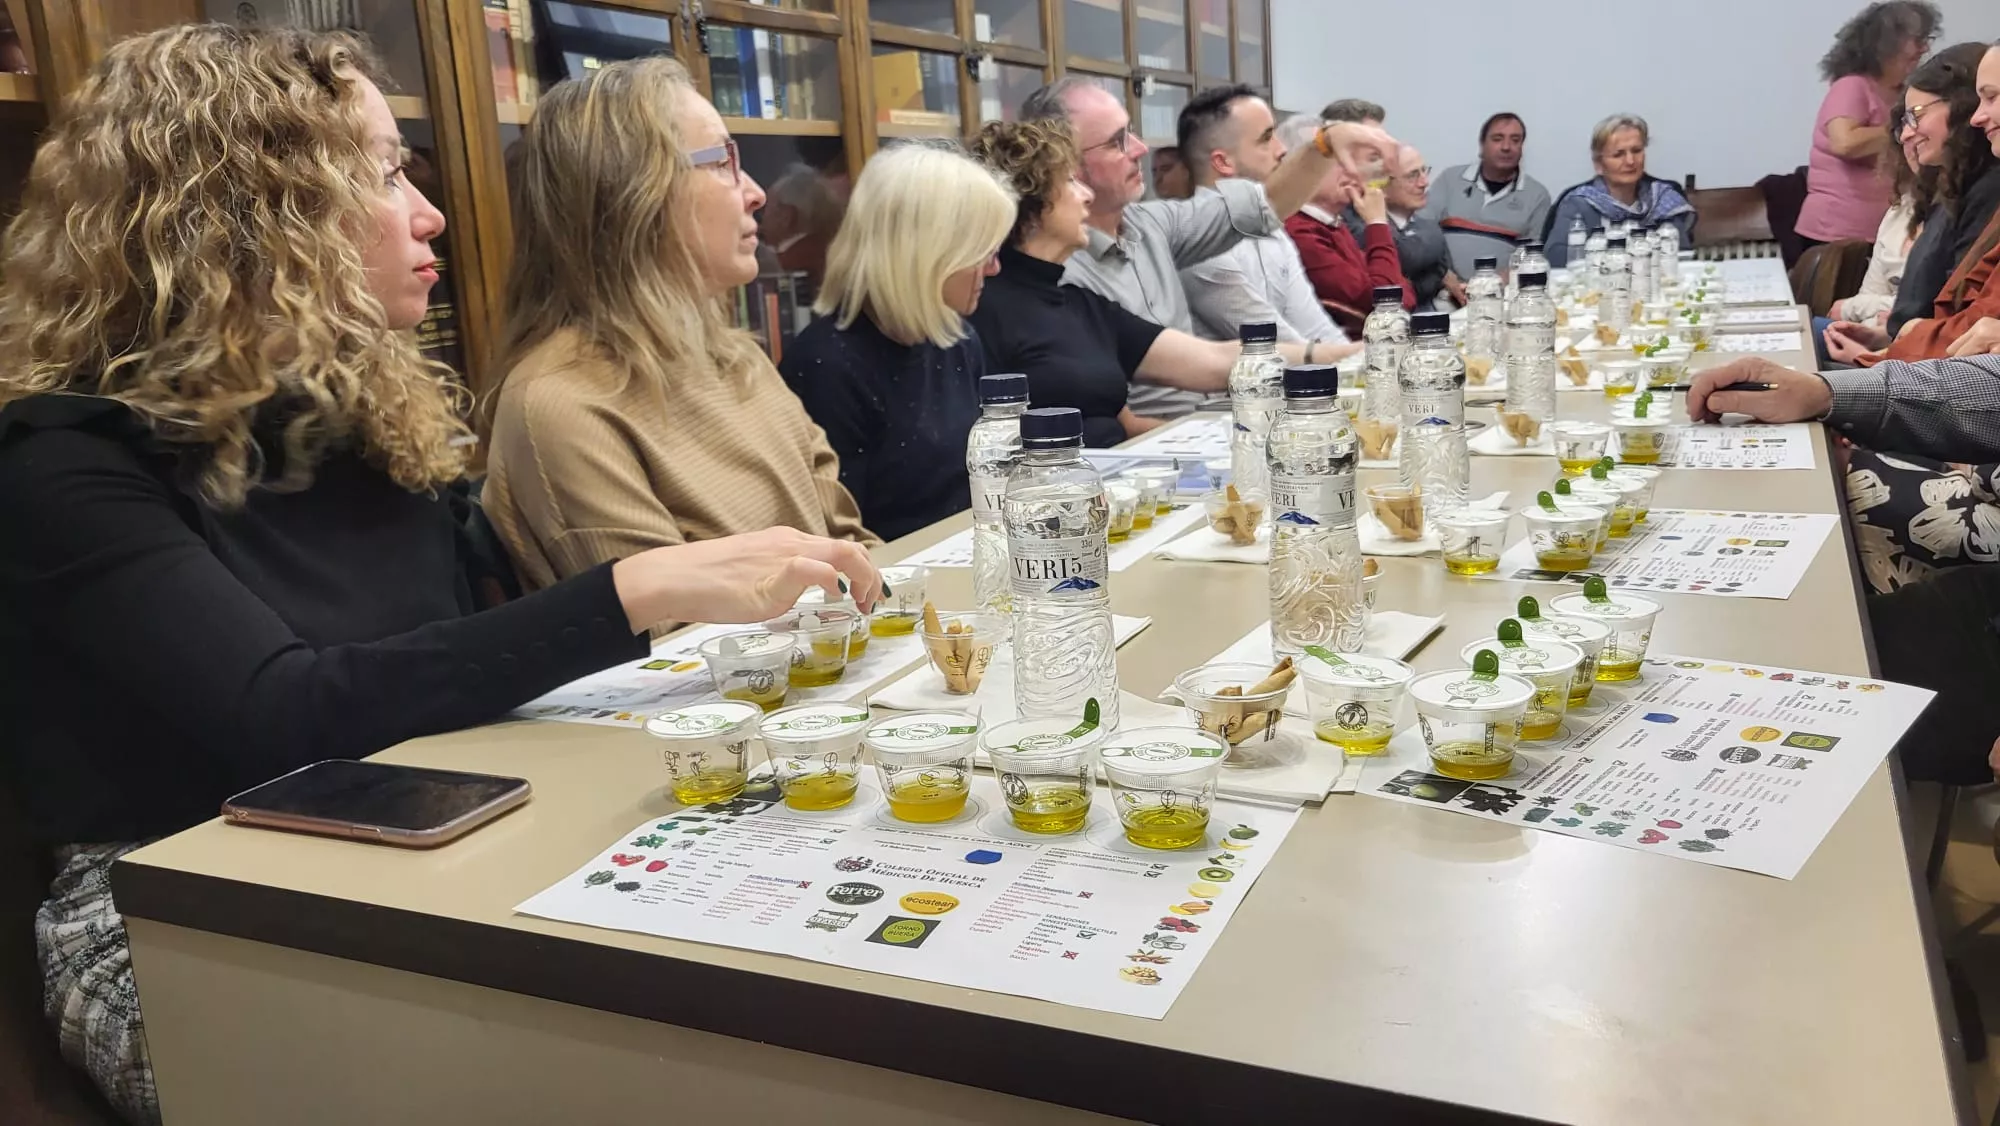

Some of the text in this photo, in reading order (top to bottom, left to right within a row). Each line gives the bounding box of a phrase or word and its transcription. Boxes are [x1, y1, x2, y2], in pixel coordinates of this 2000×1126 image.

[1408, 404, 1434, 414] VERI
[876, 862, 922, 873] COLEGIO
[926, 869, 967, 879] OFICIAL
[869, 868, 917, 879] MÉDICOS
[939, 877, 981, 888] HUESCA
[827, 885, 882, 898] Ferrer
[906, 897, 955, 908] ecostean
[893, 924, 921, 932] TORNO
